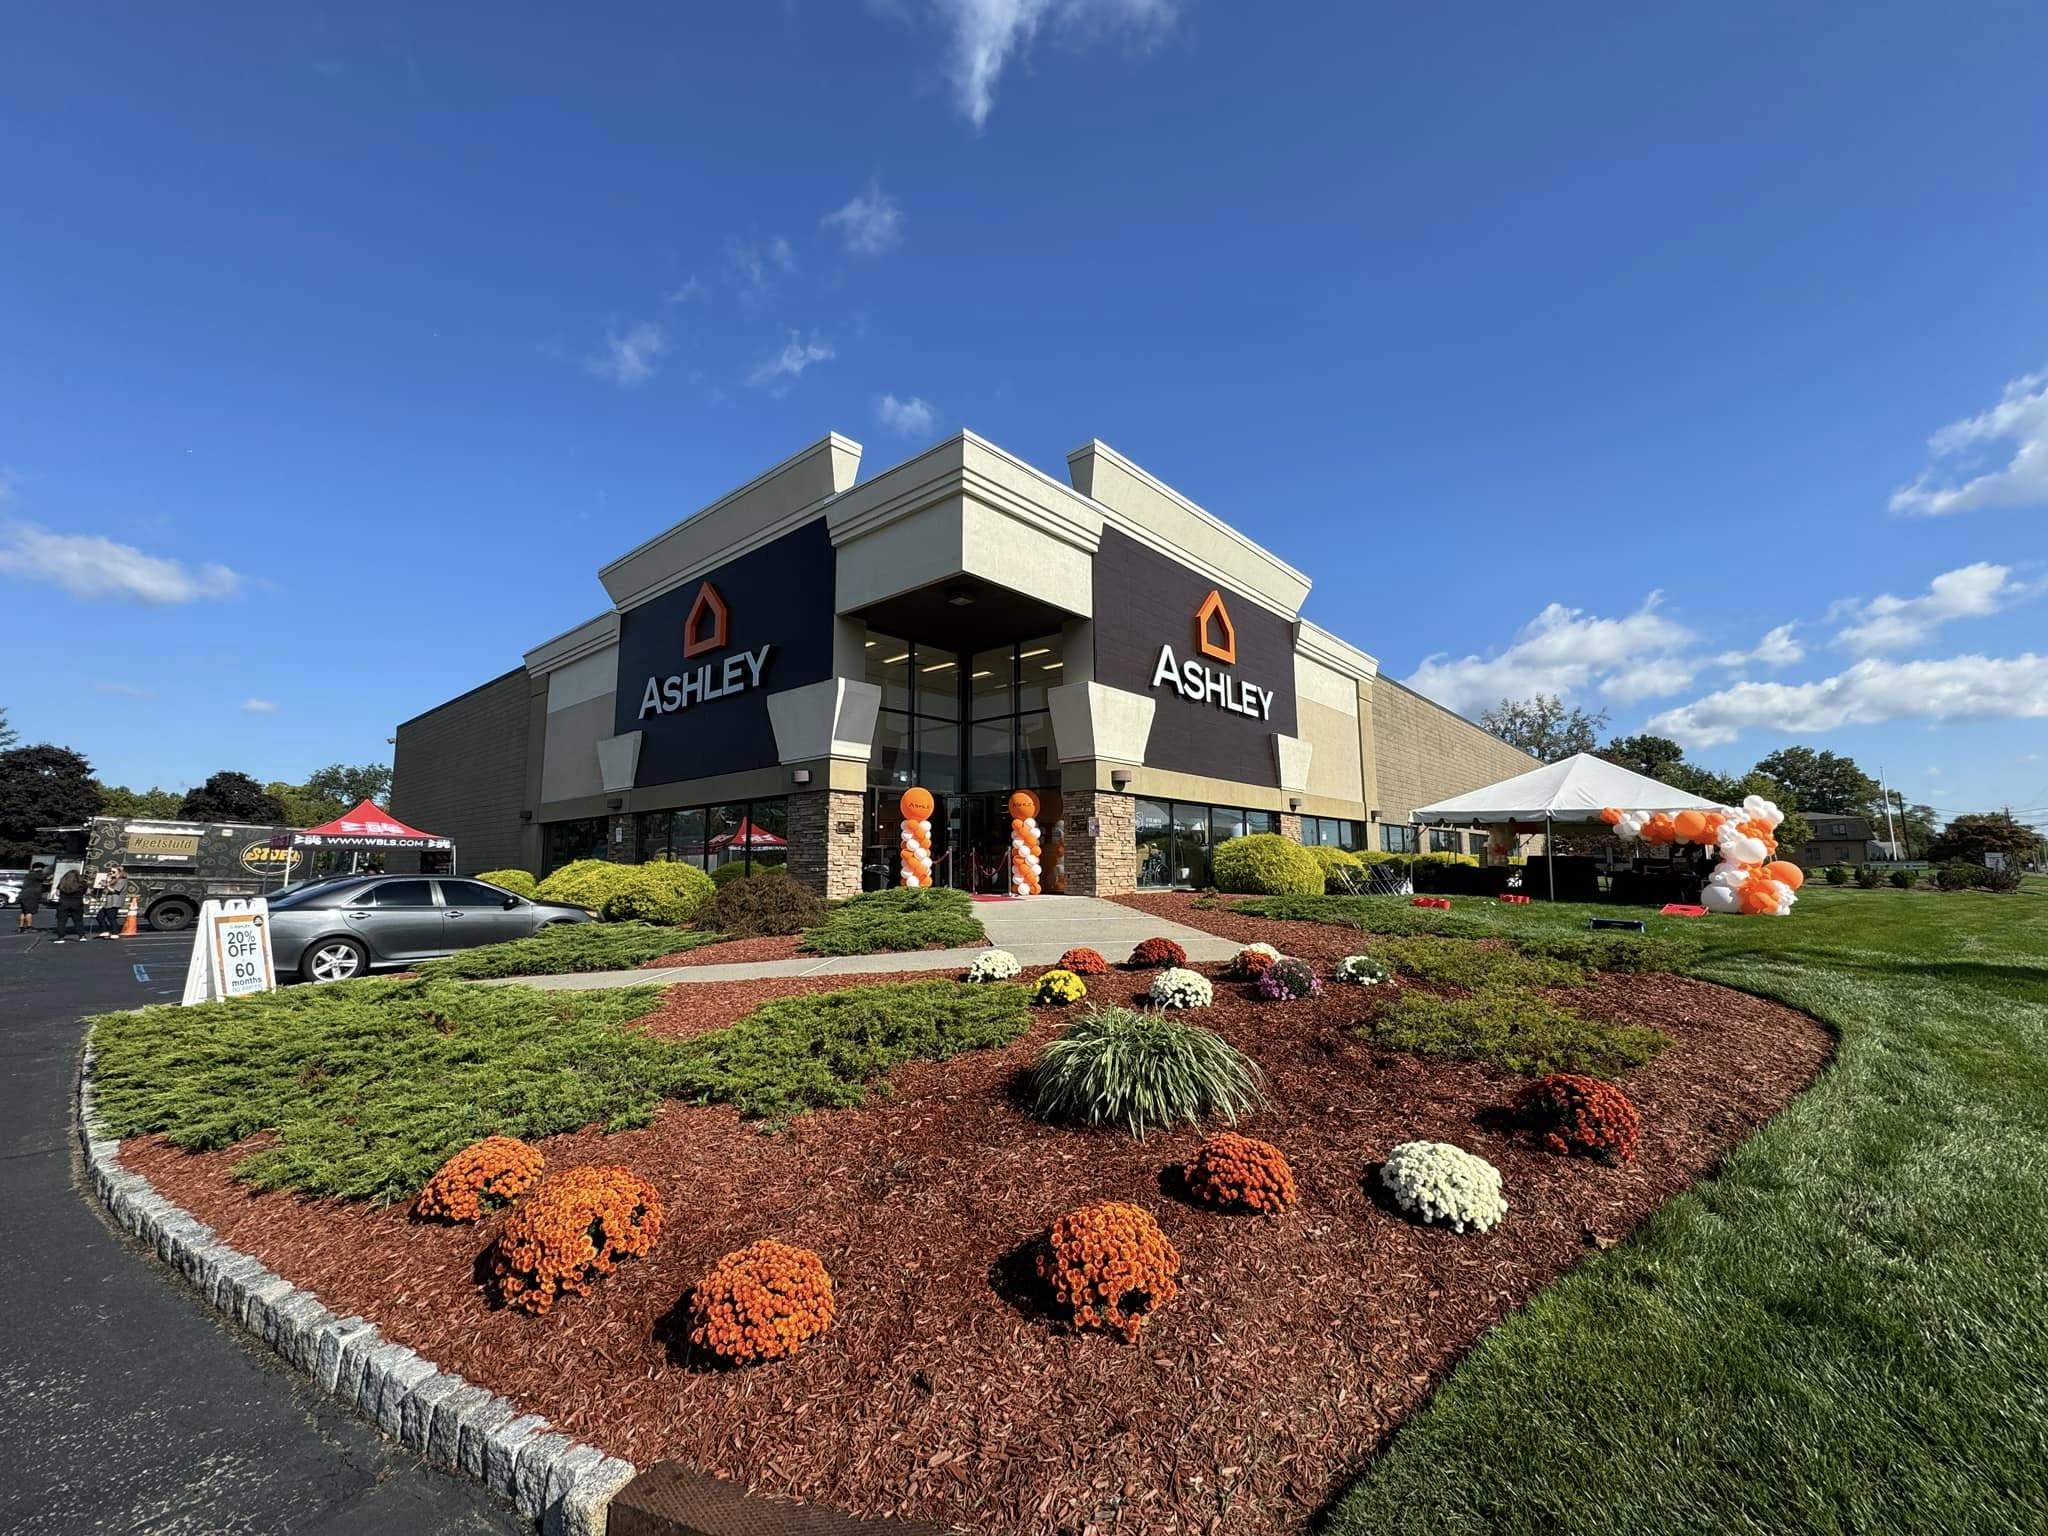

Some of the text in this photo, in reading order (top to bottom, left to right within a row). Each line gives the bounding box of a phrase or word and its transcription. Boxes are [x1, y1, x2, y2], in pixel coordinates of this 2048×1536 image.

[638, 643, 770, 719] ASHLEY
[1152, 644, 1274, 721] ASHLEY
[327, 837, 424, 847] WWW.WBLS.COM
[227, 930, 256, 944] 20%
[228, 942, 257, 957] OFF
[235, 962, 255, 978] 60
[231, 976, 263, 987] months
